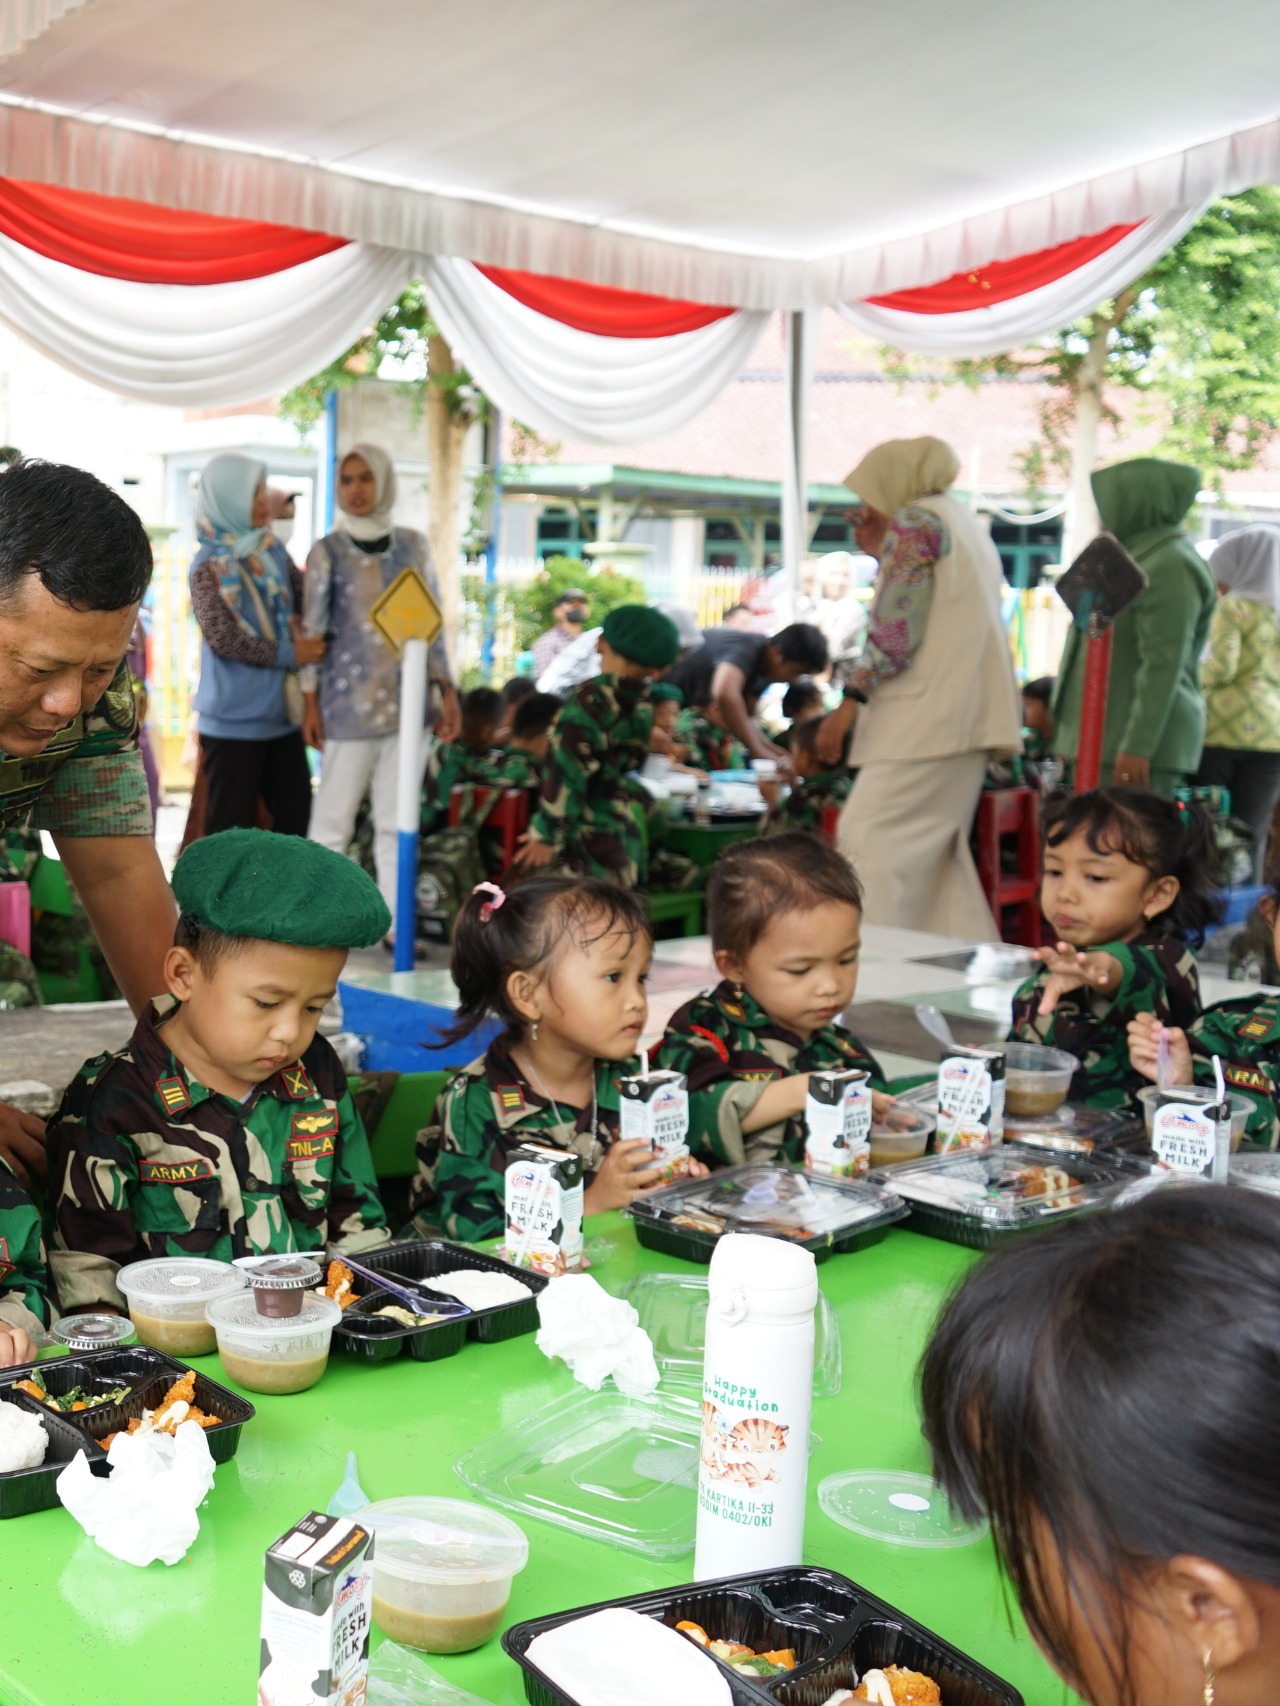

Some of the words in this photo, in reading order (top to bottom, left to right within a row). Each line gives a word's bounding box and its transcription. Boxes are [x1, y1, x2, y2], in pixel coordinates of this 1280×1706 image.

[1226, 1068, 1266, 1087] ARM
[655, 1119, 686, 1134] FRESH
[847, 1128, 865, 1140] MILK
[659, 1131, 682, 1143] MILK
[290, 1137, 336, 1156] TNI-A
[1160, 1140, 1207, 1157] FRESH
[1165, 1153, 1200, 1167] MILK
[150, 1164, 198, 1180] ARMY
[714, 1375, 756, 1398] Happy
[707, 1488, 743, 1511] KARTIKA
[723, 1508, 772, 1527] 0402/OKI
[348, 1601, 364, 1618] with
[332, 1611, 367, 1659] FRESH
[334, 1635, 360, 1673] MILK
